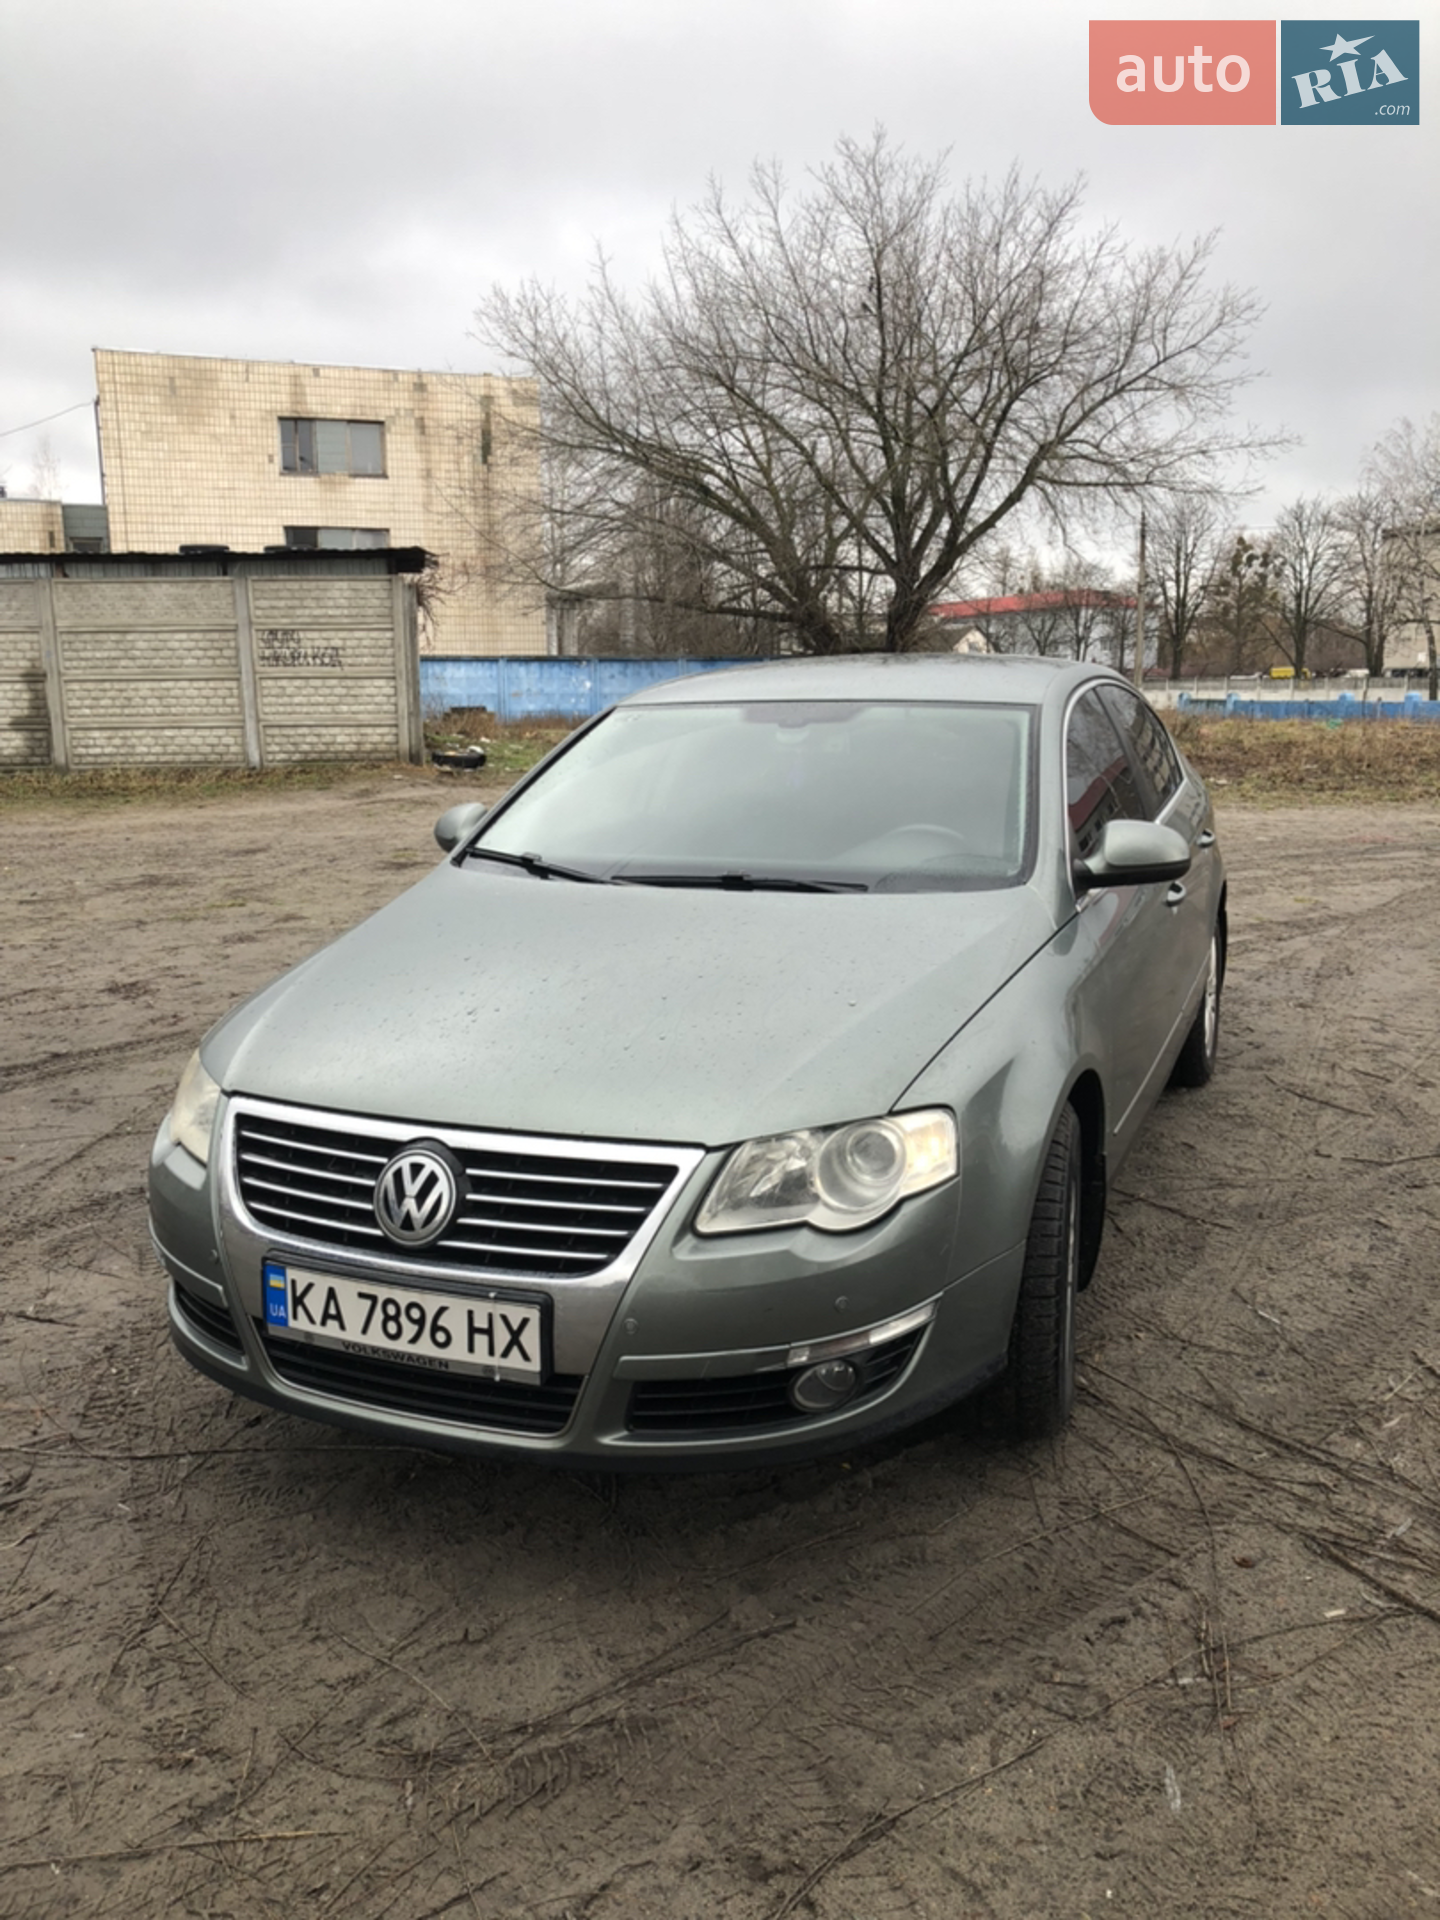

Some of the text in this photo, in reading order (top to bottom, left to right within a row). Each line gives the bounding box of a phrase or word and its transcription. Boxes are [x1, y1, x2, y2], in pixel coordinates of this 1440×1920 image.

[270, 1305, 287, 1318] UA
[291, 1279, 531, 1362] KA 7896 HX
[341, 1341, 449, 1370] VOLKSWAGEN
